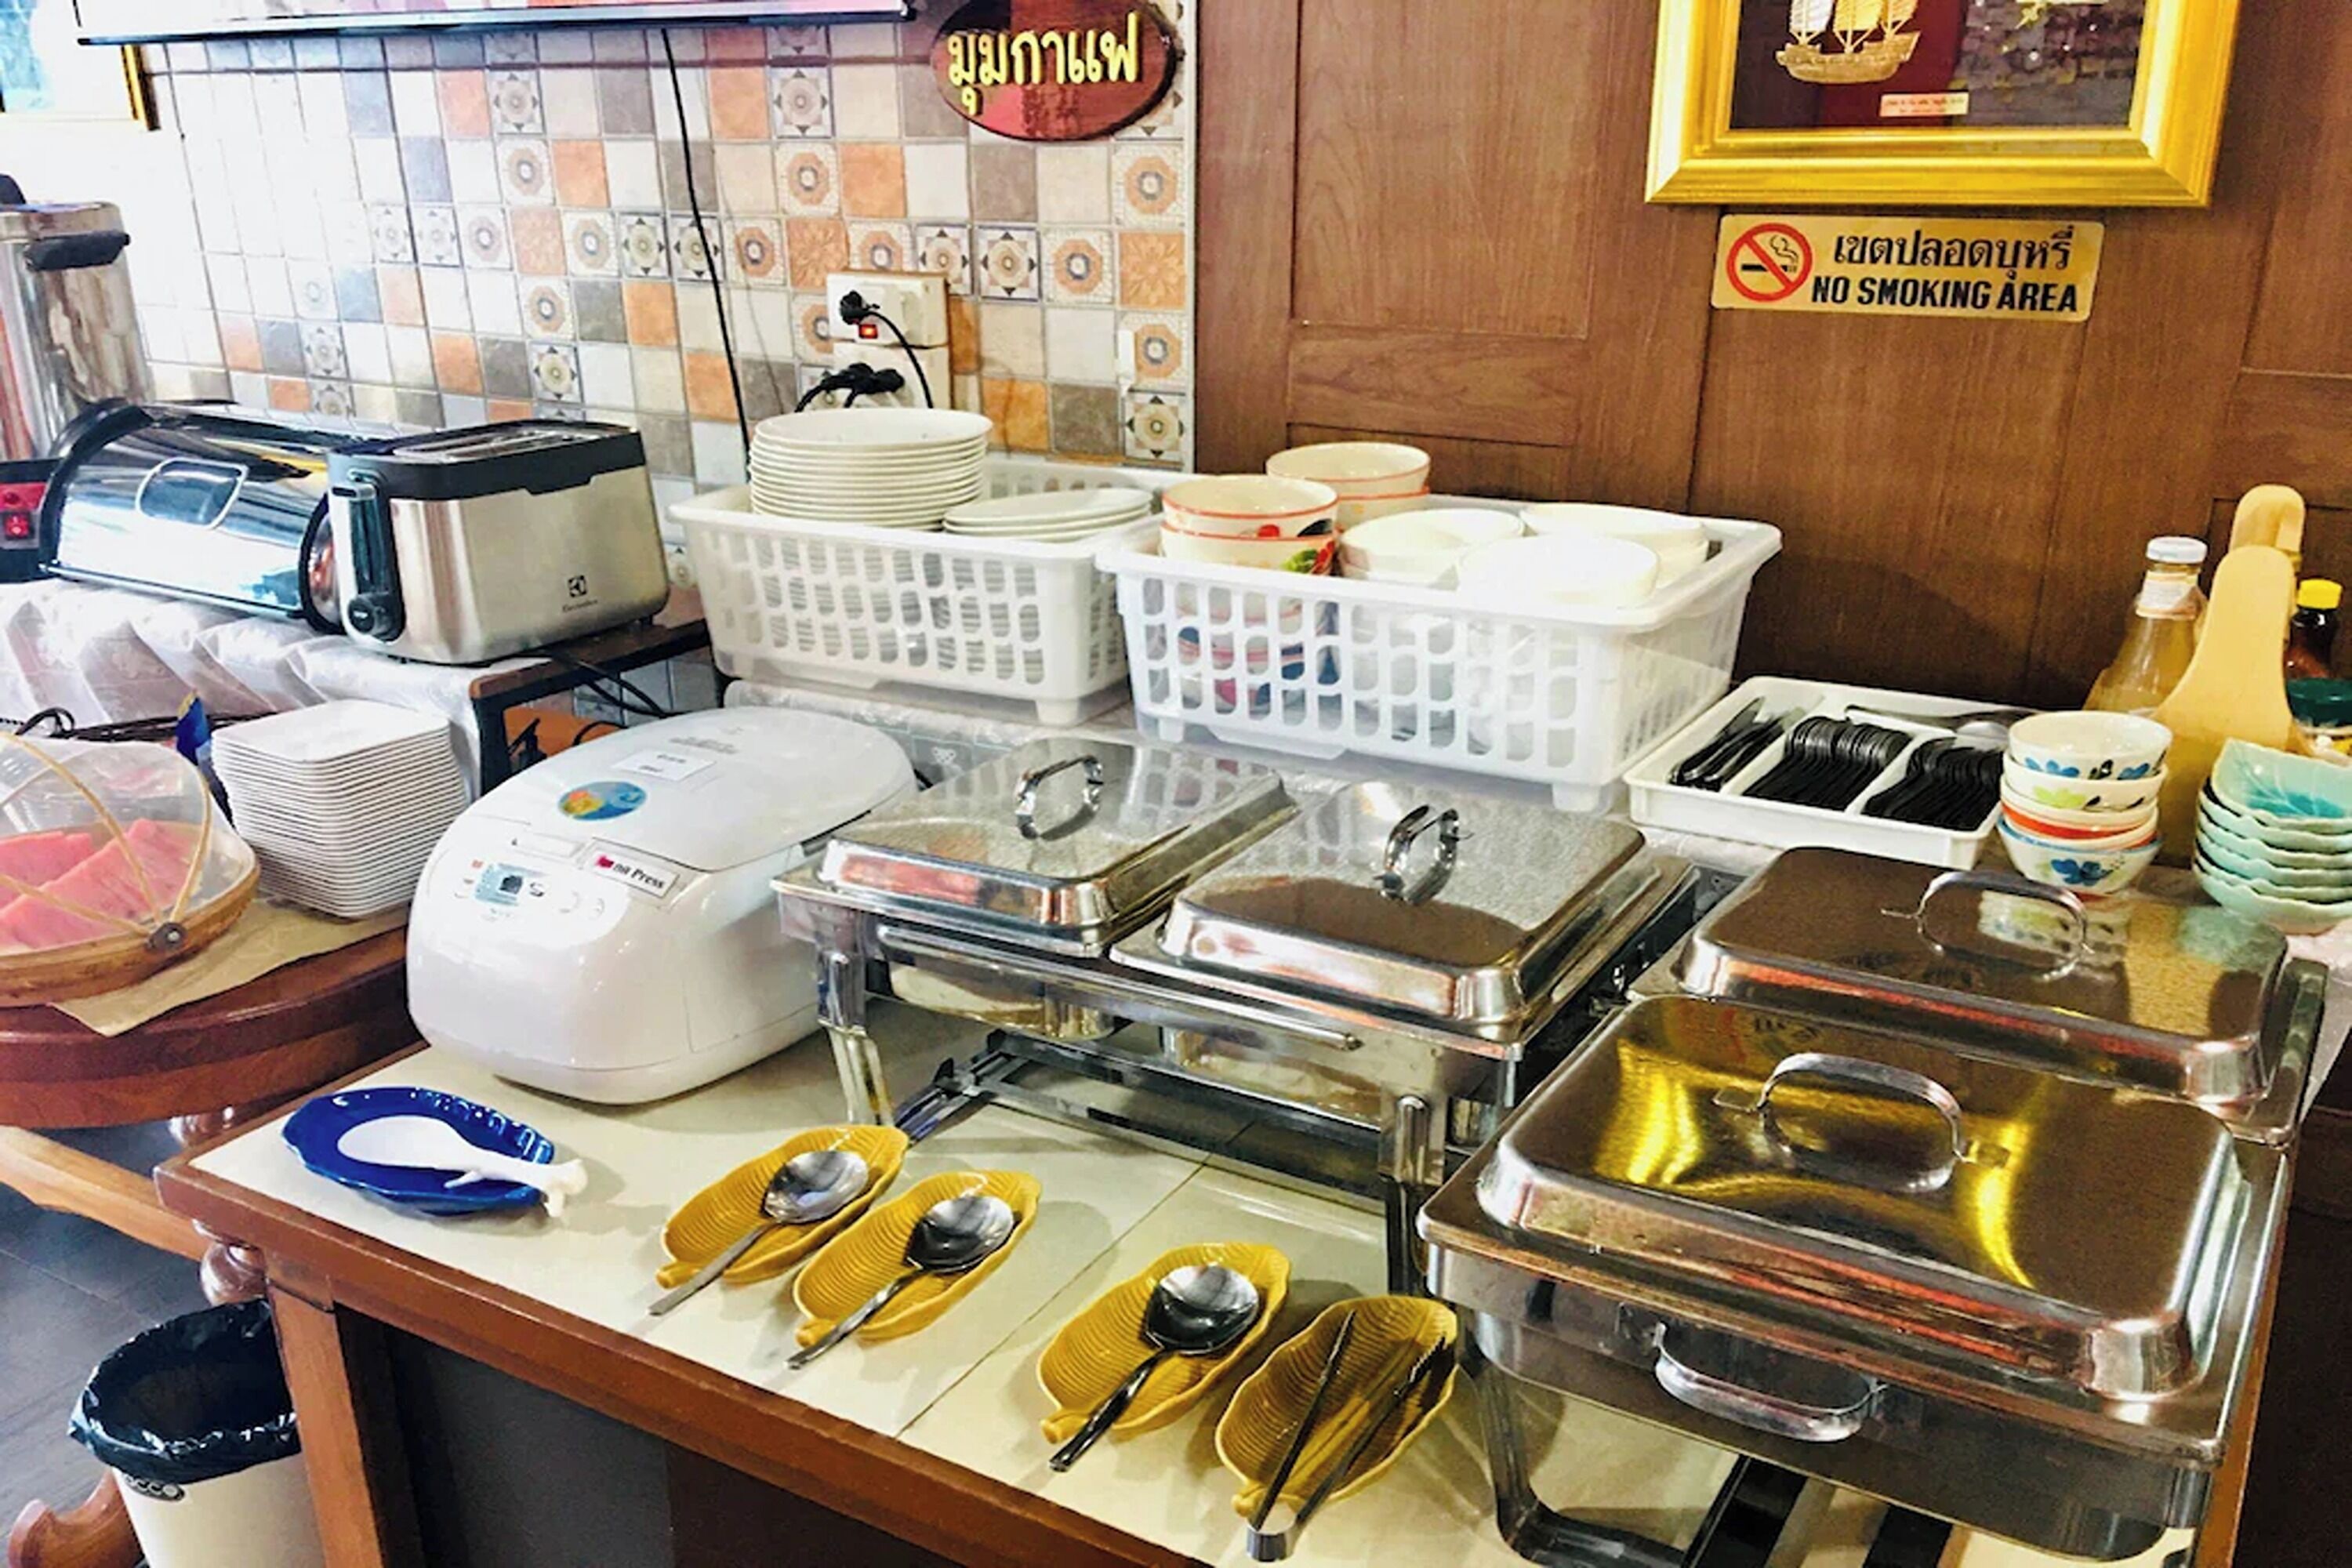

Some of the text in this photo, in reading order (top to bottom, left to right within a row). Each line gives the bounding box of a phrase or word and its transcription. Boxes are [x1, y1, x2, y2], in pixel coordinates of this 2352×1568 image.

[947, 11, 1139, 115] มุมกาแฟ
[1834, 224, 2074, 280] เขตปลอดบุหรี่
[1812, 276, 2078, 312] NO SMOKING AREA
